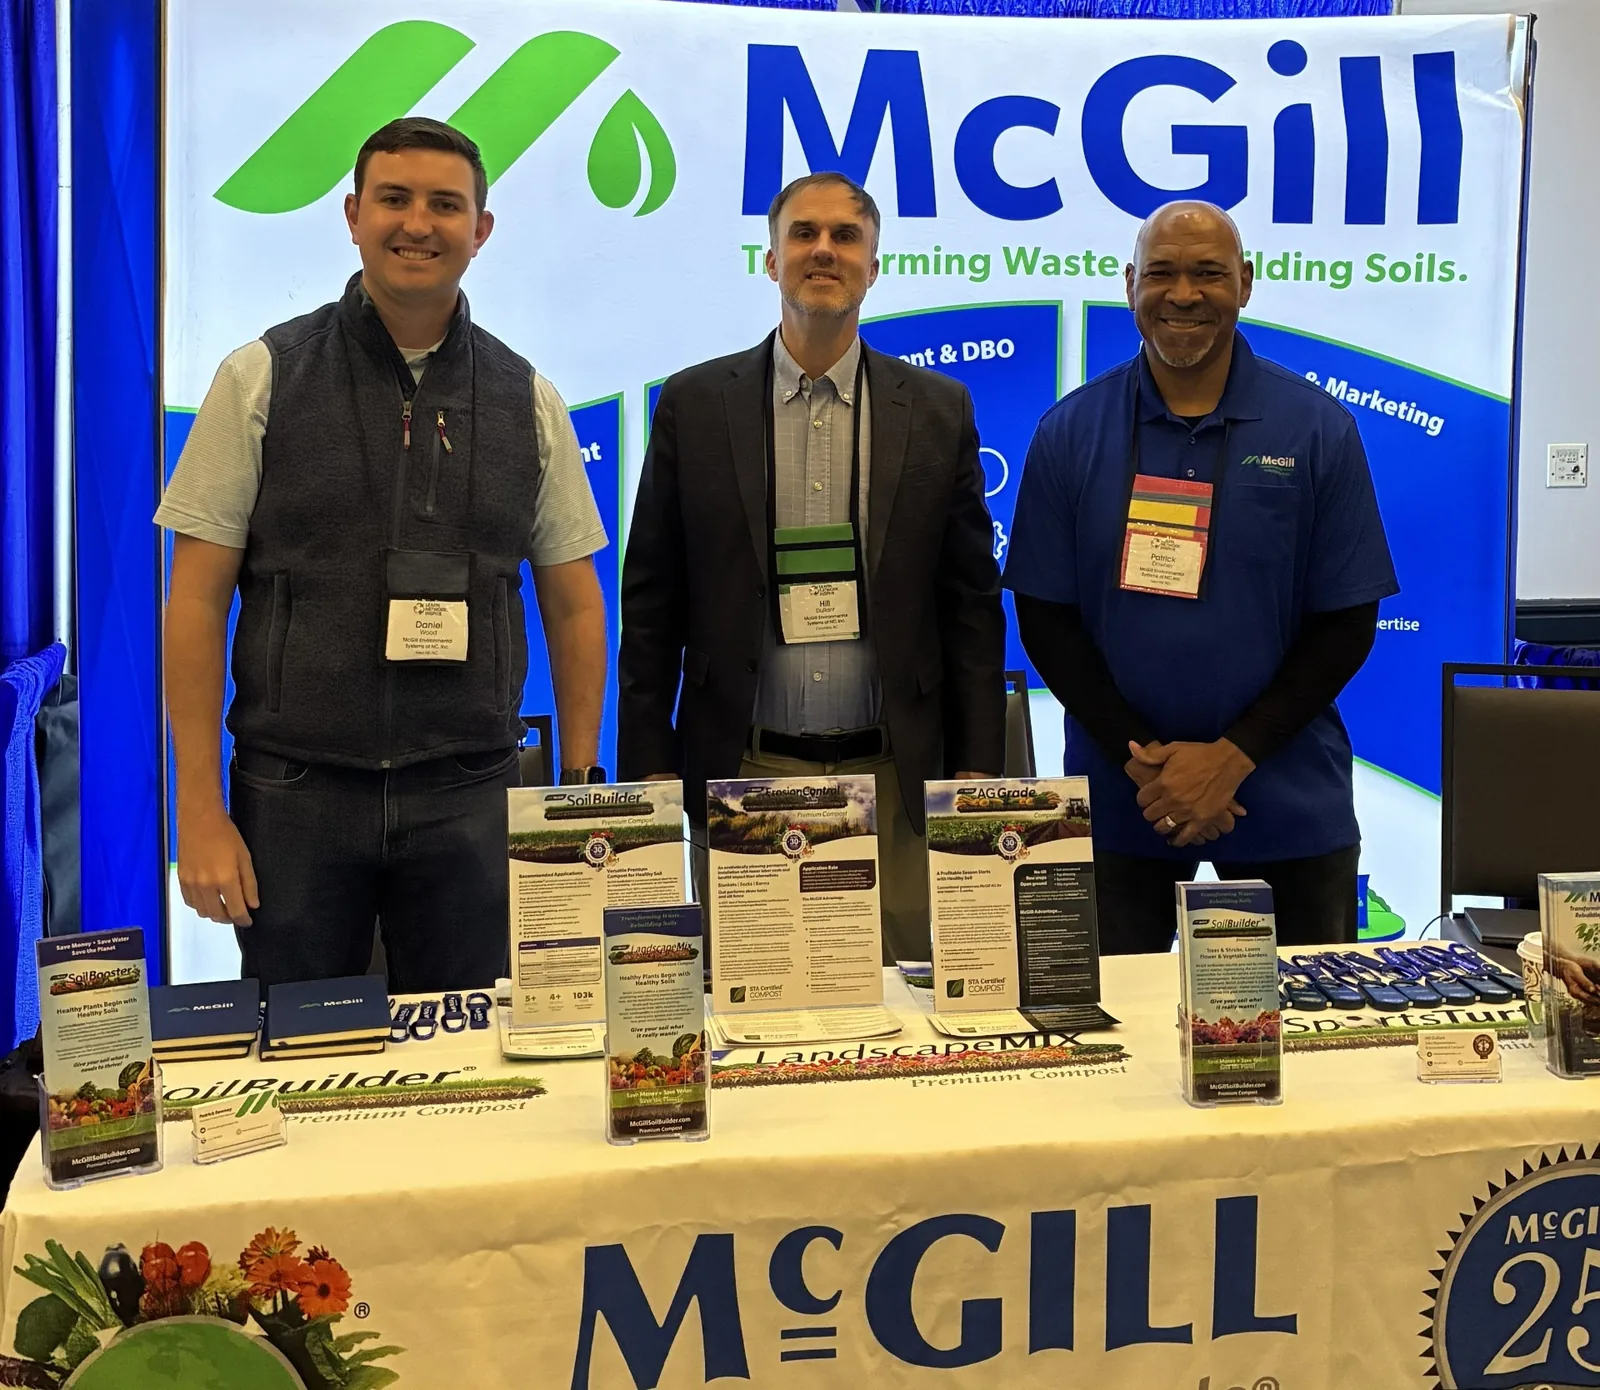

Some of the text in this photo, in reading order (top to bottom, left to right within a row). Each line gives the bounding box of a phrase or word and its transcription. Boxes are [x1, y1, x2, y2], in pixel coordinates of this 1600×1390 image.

[741, 39, 1463, 224] McGill
[1365, 252, 1468, 283] Soils.
[940, 344, 958, 364] &
[962, 338, 1015, 361] DBO
[1324, 376, 1445, 437] Marketing
[1261, 455, 1295, 468] McGill
[1151, 553, 1176, 562] Patrick
[415, 621, 443, 629] Daniel
[978, 787, 1036, 799] AG Grade
[1212, 919, 1260, 929] SoilBuilder
[750, 990, 782, 998] COMPOST
[968, 984, 1005, 992] COMPOST
[573, 991, 593, 999] 103k
[57, 1005, 82, 1015] Healthy
[83, 1003, 103, 1012] Plants
[104, 999, 122, 1007] Begin
[193, 1002, 234, 1011] McGill
[323, 998, 363, 1007] McGill
[77, 1010, 102, 1018] Healthy
[911, 1065, 1128, 1088] Premium Compost
[416, 1101, 526, 1118] Compost
[630, 1117, 691, 1127] McGillSoilBuilder.com
[71, 1147, 140, 1166] McGillSoilBuilder.com
[1483, 1247, 1600, 1376] 25
